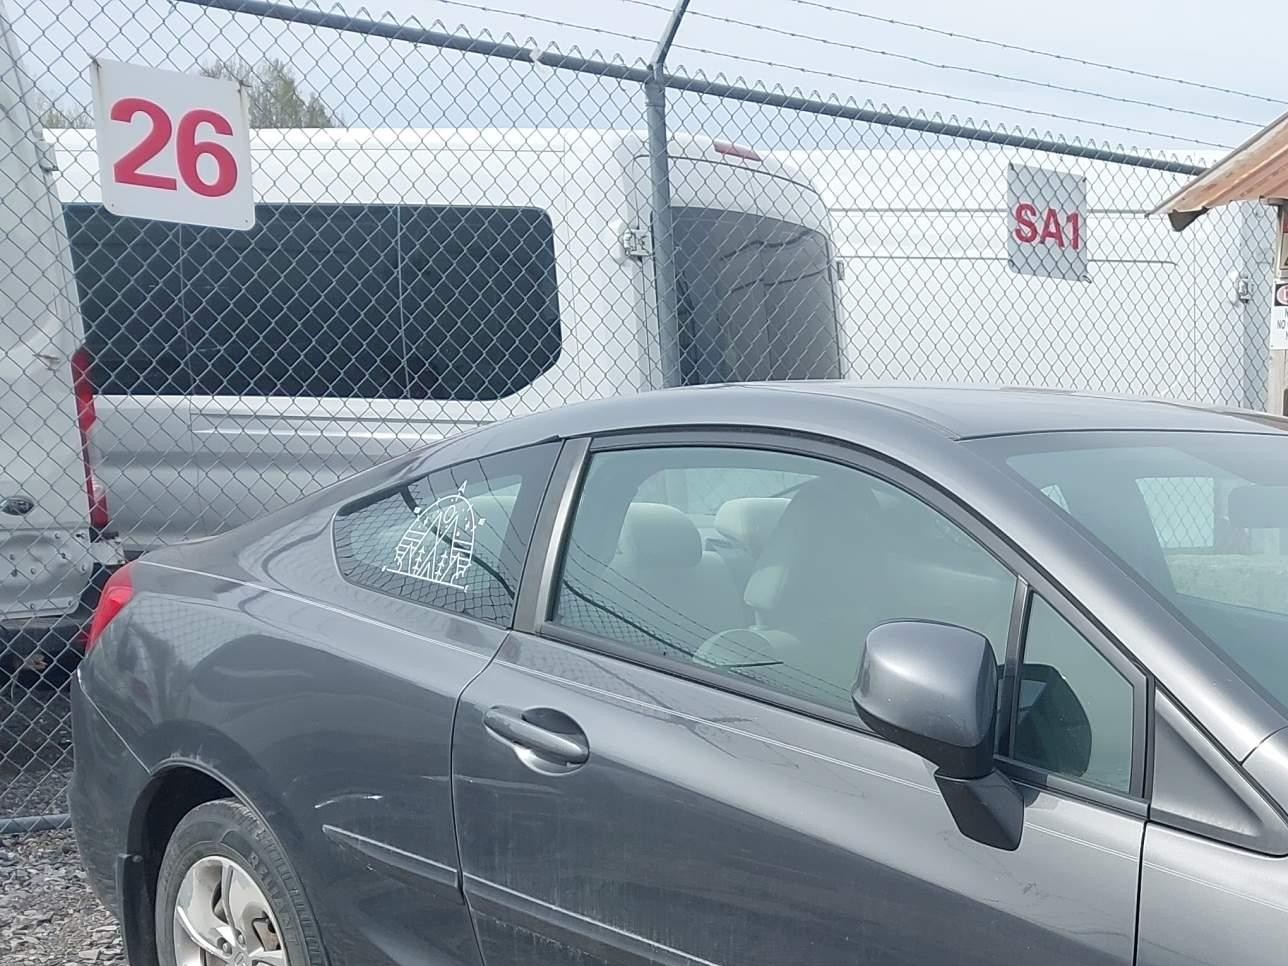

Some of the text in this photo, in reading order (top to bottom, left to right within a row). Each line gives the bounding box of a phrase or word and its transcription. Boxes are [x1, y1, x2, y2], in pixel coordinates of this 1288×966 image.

[110, 97, 238, 198] 26
[1015, 203, 1079, 251] SA1
[1276, 319, 1286, 330] NO
